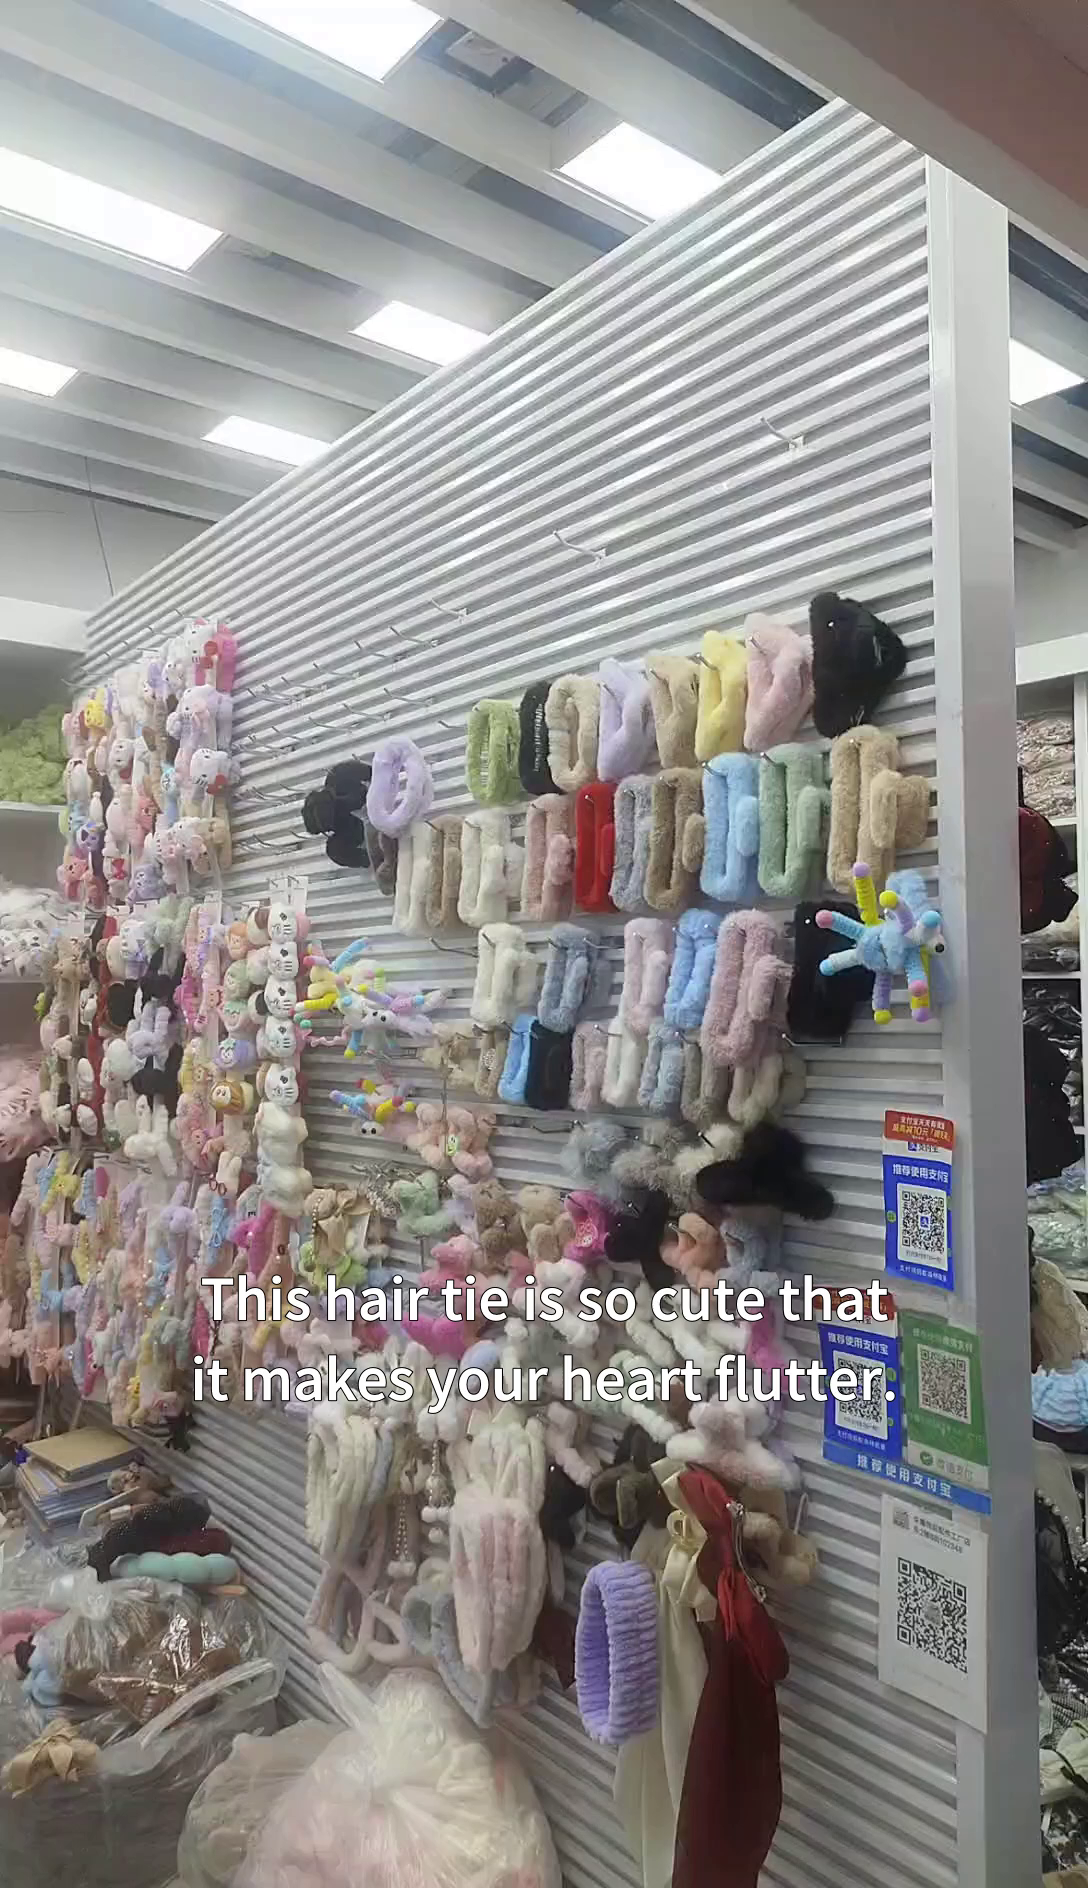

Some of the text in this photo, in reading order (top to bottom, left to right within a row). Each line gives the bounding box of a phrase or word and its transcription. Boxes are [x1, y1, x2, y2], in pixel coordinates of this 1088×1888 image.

[892, 1163, 949, 1184] 推荐使用支付宝
[827, 1331, 889, 1355] 推荐使用支付宝
[857, 1453, 953, 1499] 推荐使用支付宝
